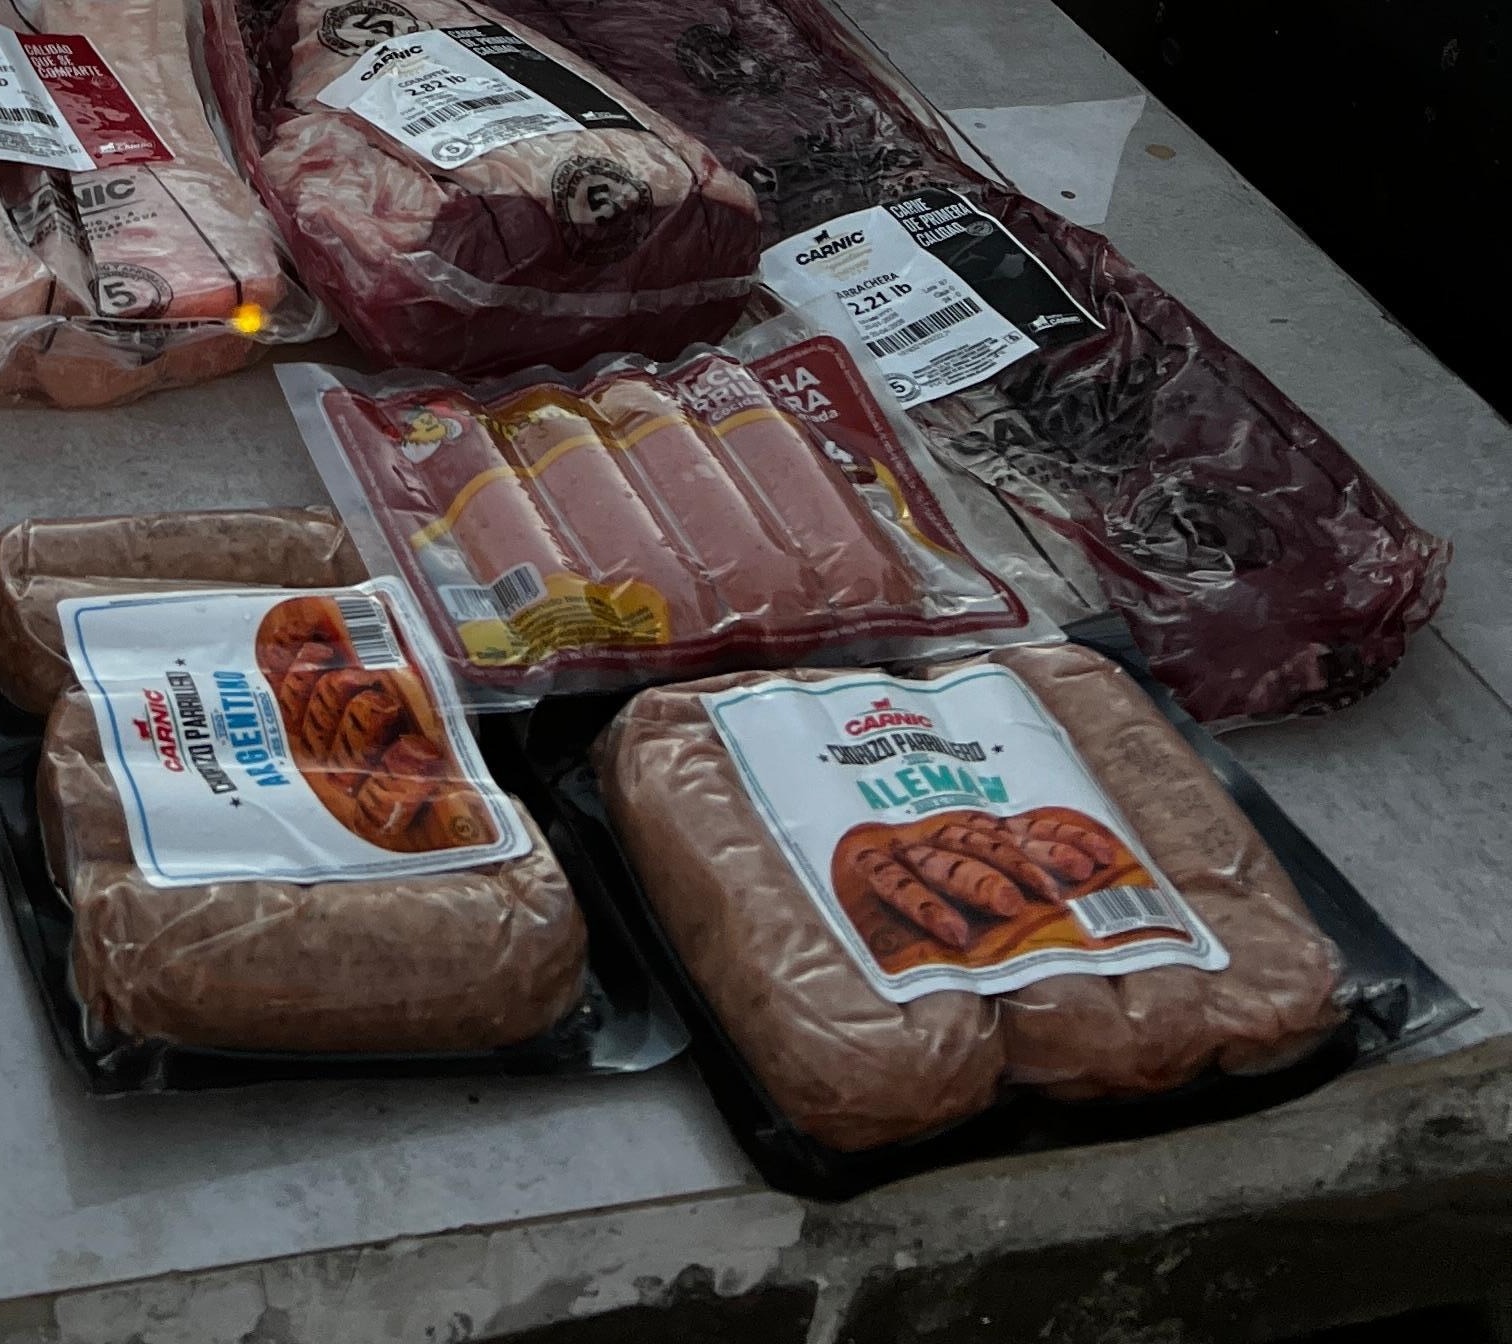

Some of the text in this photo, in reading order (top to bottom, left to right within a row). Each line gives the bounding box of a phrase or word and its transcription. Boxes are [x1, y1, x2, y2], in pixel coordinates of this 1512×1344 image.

[25, 43, 72, 57] CALIDAD
[31, 55, 57, 68] QUE
[39, 65, 103, 80] COMPARTE
[889, 197, 930, 219] CARNE
[903, 202, 973, 232] DE PRIMERA
[917, 222, 967, 247] CALIDAD
[795, 230, 864, 266] CARNIC
[103, 281, 137, 308] 5
[847, 290, 891, 316] 2.21
[889, 282, 913, 298] lb
[143, 688, 185, 774] CARNIC
[845, 712, 934, 737] CARNIC
